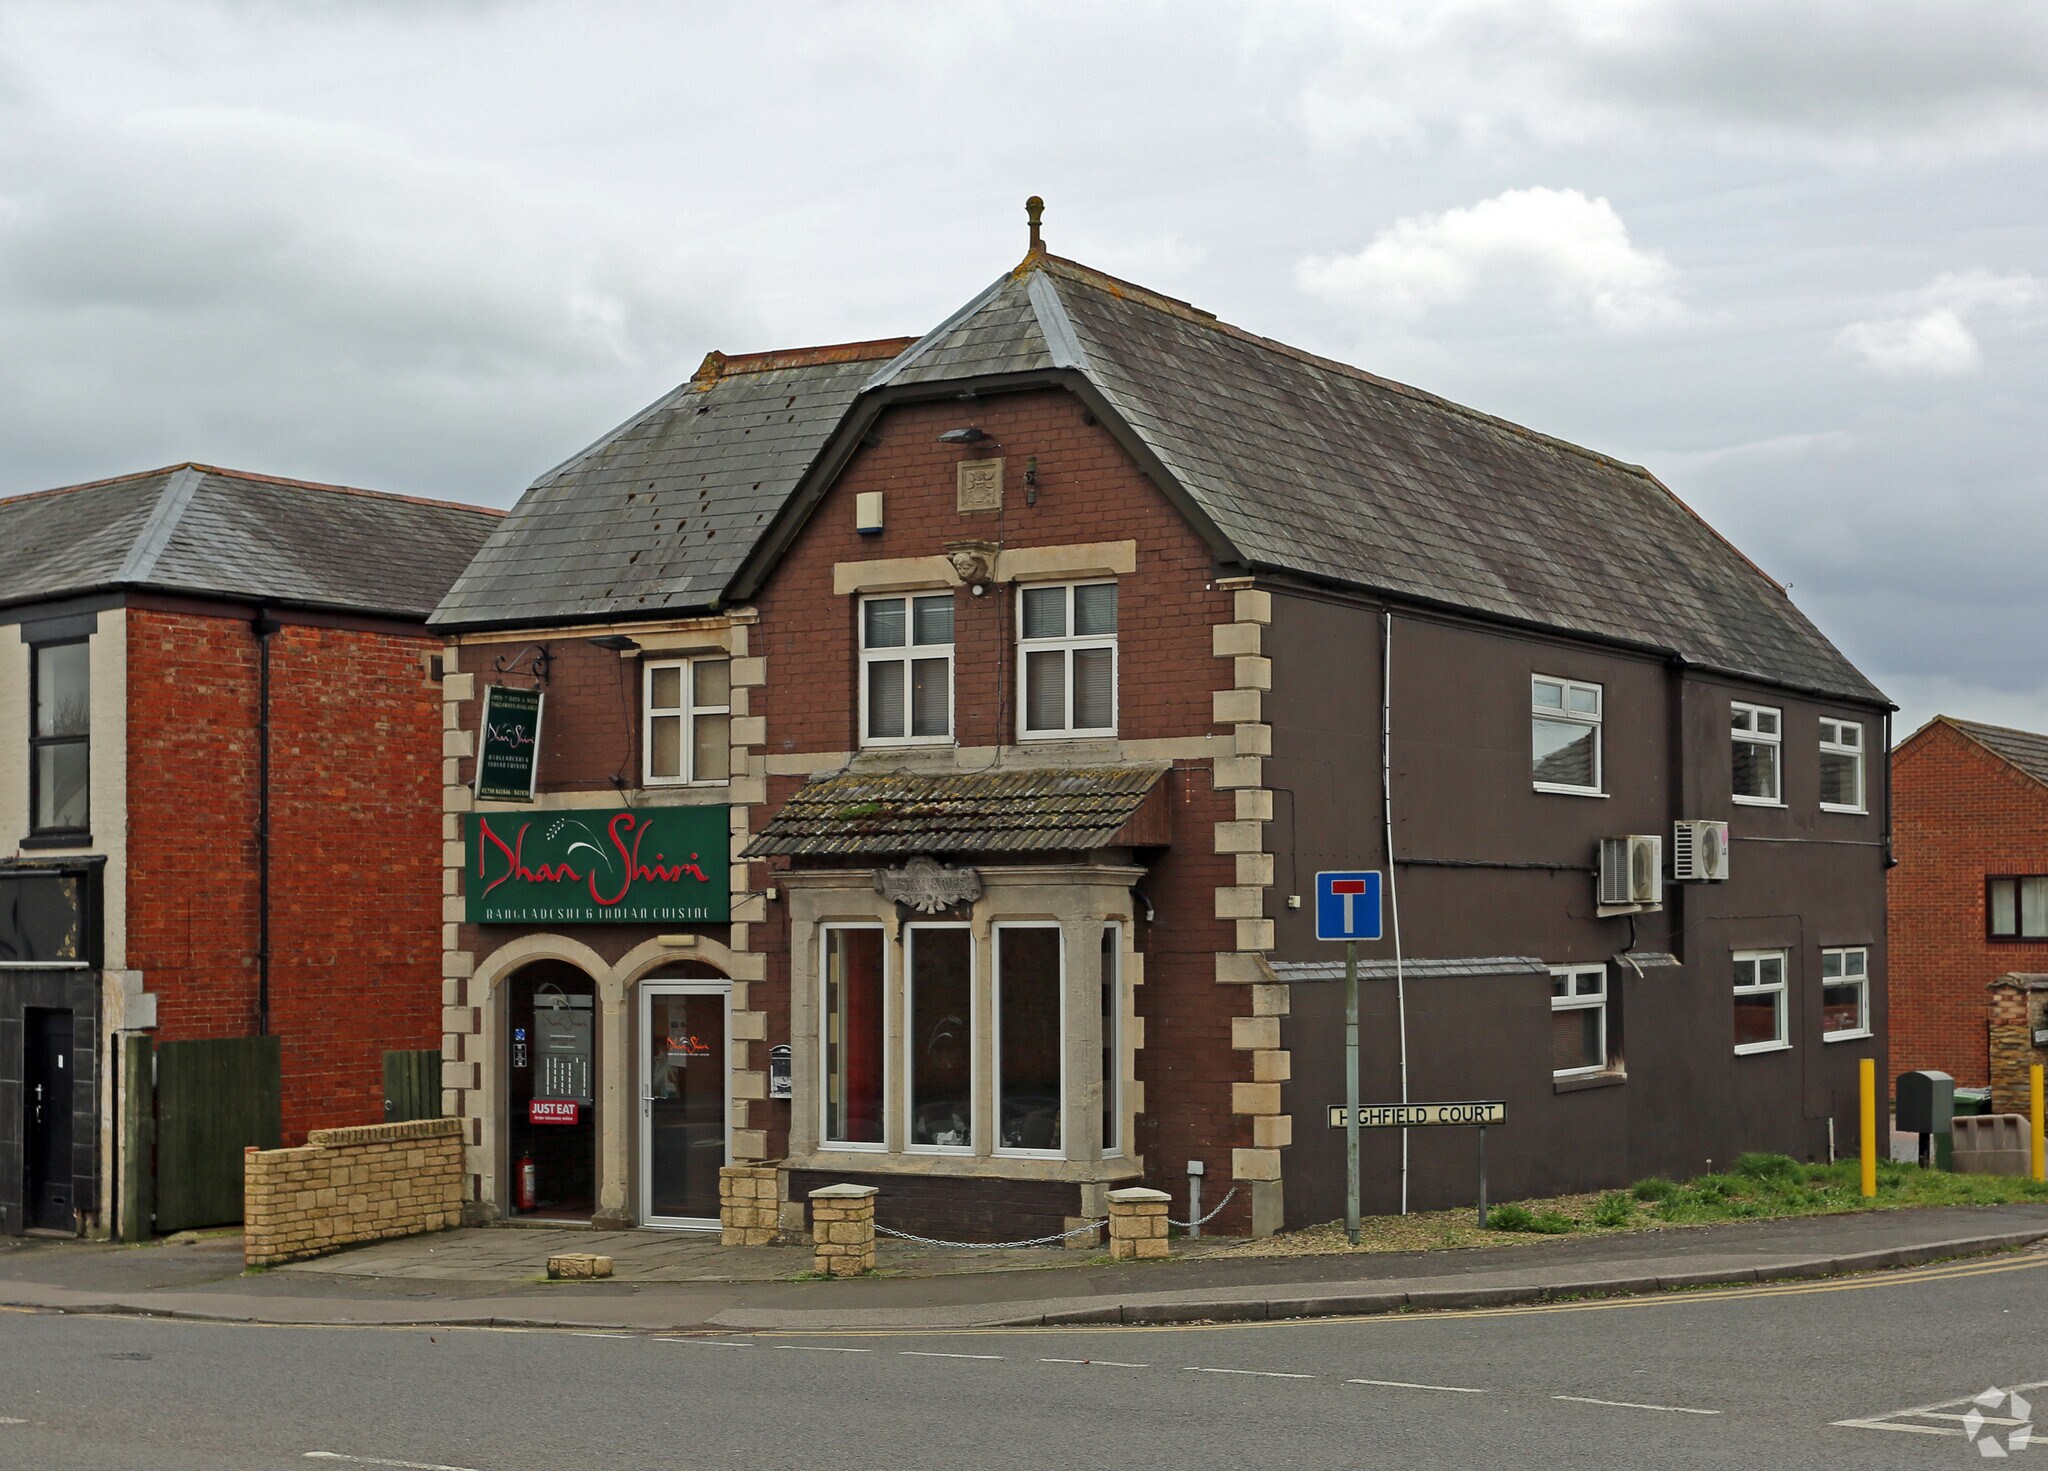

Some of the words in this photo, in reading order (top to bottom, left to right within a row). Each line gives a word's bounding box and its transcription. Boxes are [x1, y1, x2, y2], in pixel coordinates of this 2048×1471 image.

[479, 816, 582, 899] Dhan
[589, 813, 709, 905] Shiri
[487, 908, 580, 920] BANGLADESHI
[599, 907, 647, 919] INDIAN
[653, 907, 709, 919] CUISINE
[532, 1103, 555, 1114] JUST
[556, 1104, 575, 1114] EAT
[1340, 1108, 1427, 1125] HGHFIELD
[1438, 1106, 1496, 1122] COURT
